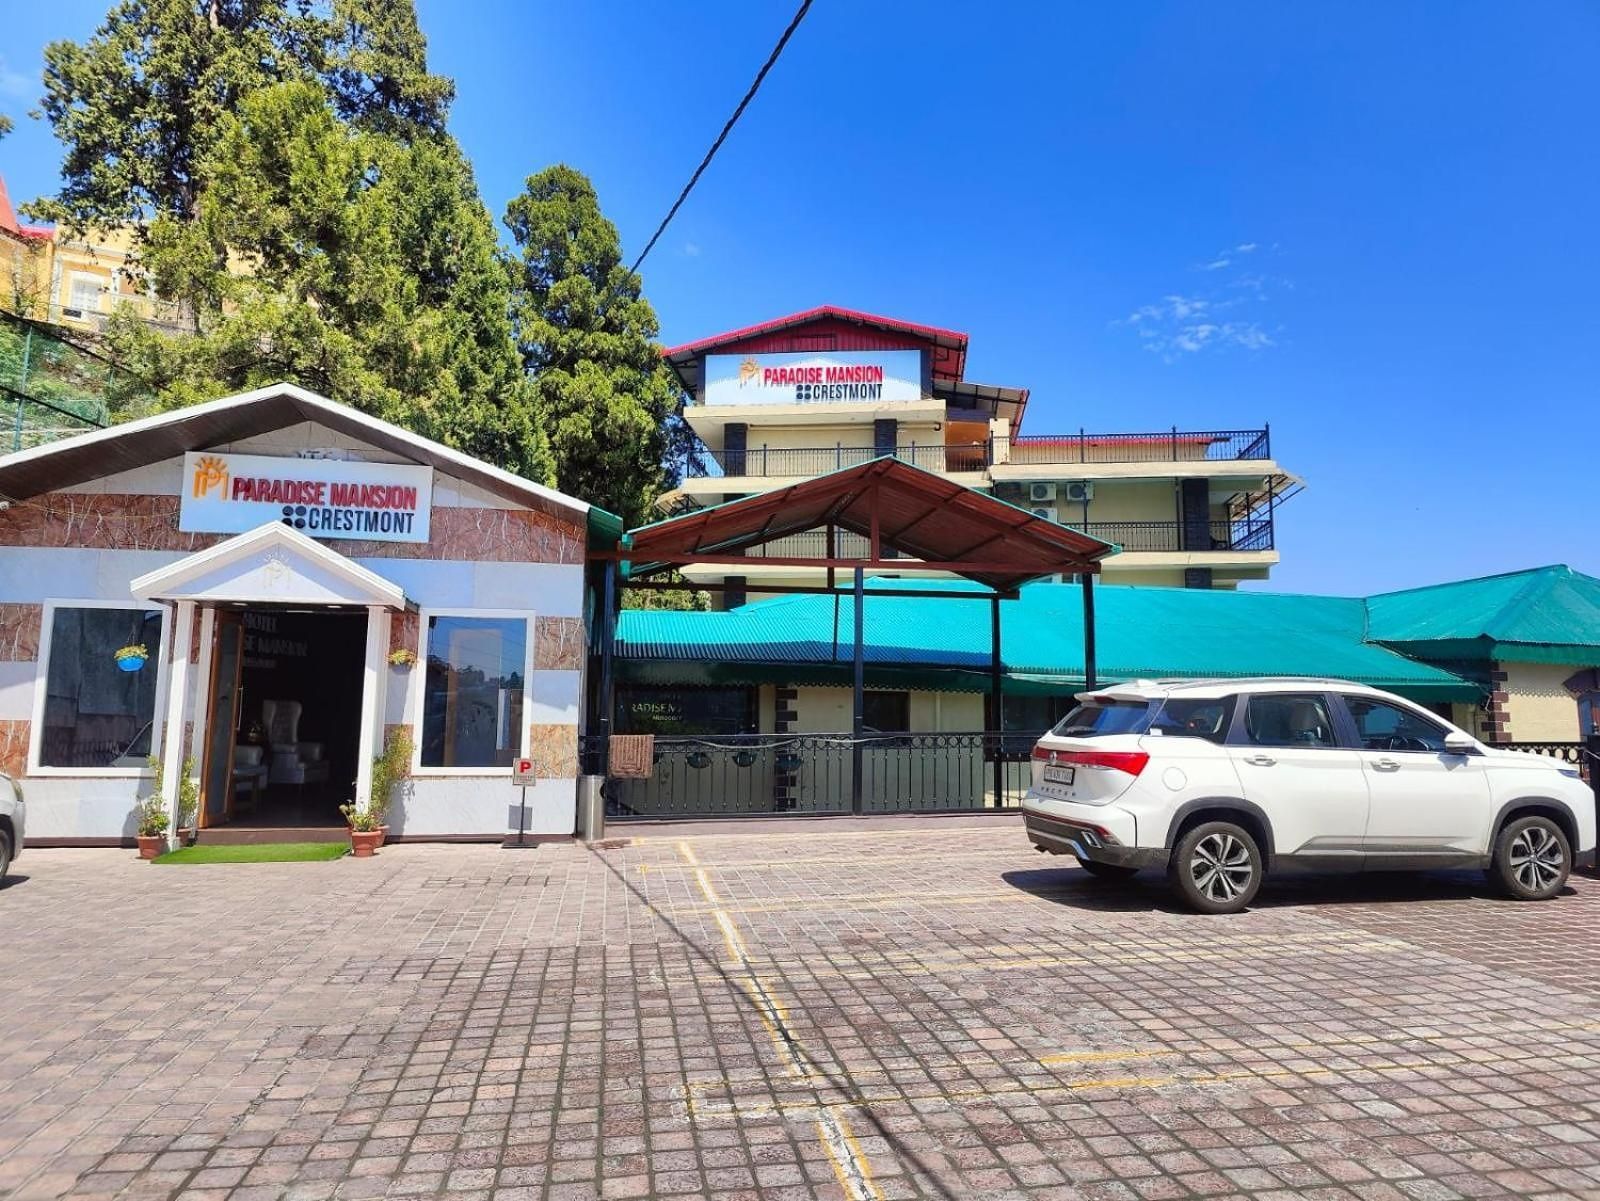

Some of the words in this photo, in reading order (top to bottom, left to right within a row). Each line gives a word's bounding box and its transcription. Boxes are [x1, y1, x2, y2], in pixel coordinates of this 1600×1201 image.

[764, 367, 823, 385] PARADISE
[826, 366, 883, 384] MANSION
[813, 384, 883, 400] CRESTMONT
[232, 477, 326, 506] PARADISE
[330, 483, 417, 510] MANSION
[309, 507, 415, 533] CRESTMONT
[520, 761, 531, 773] P
